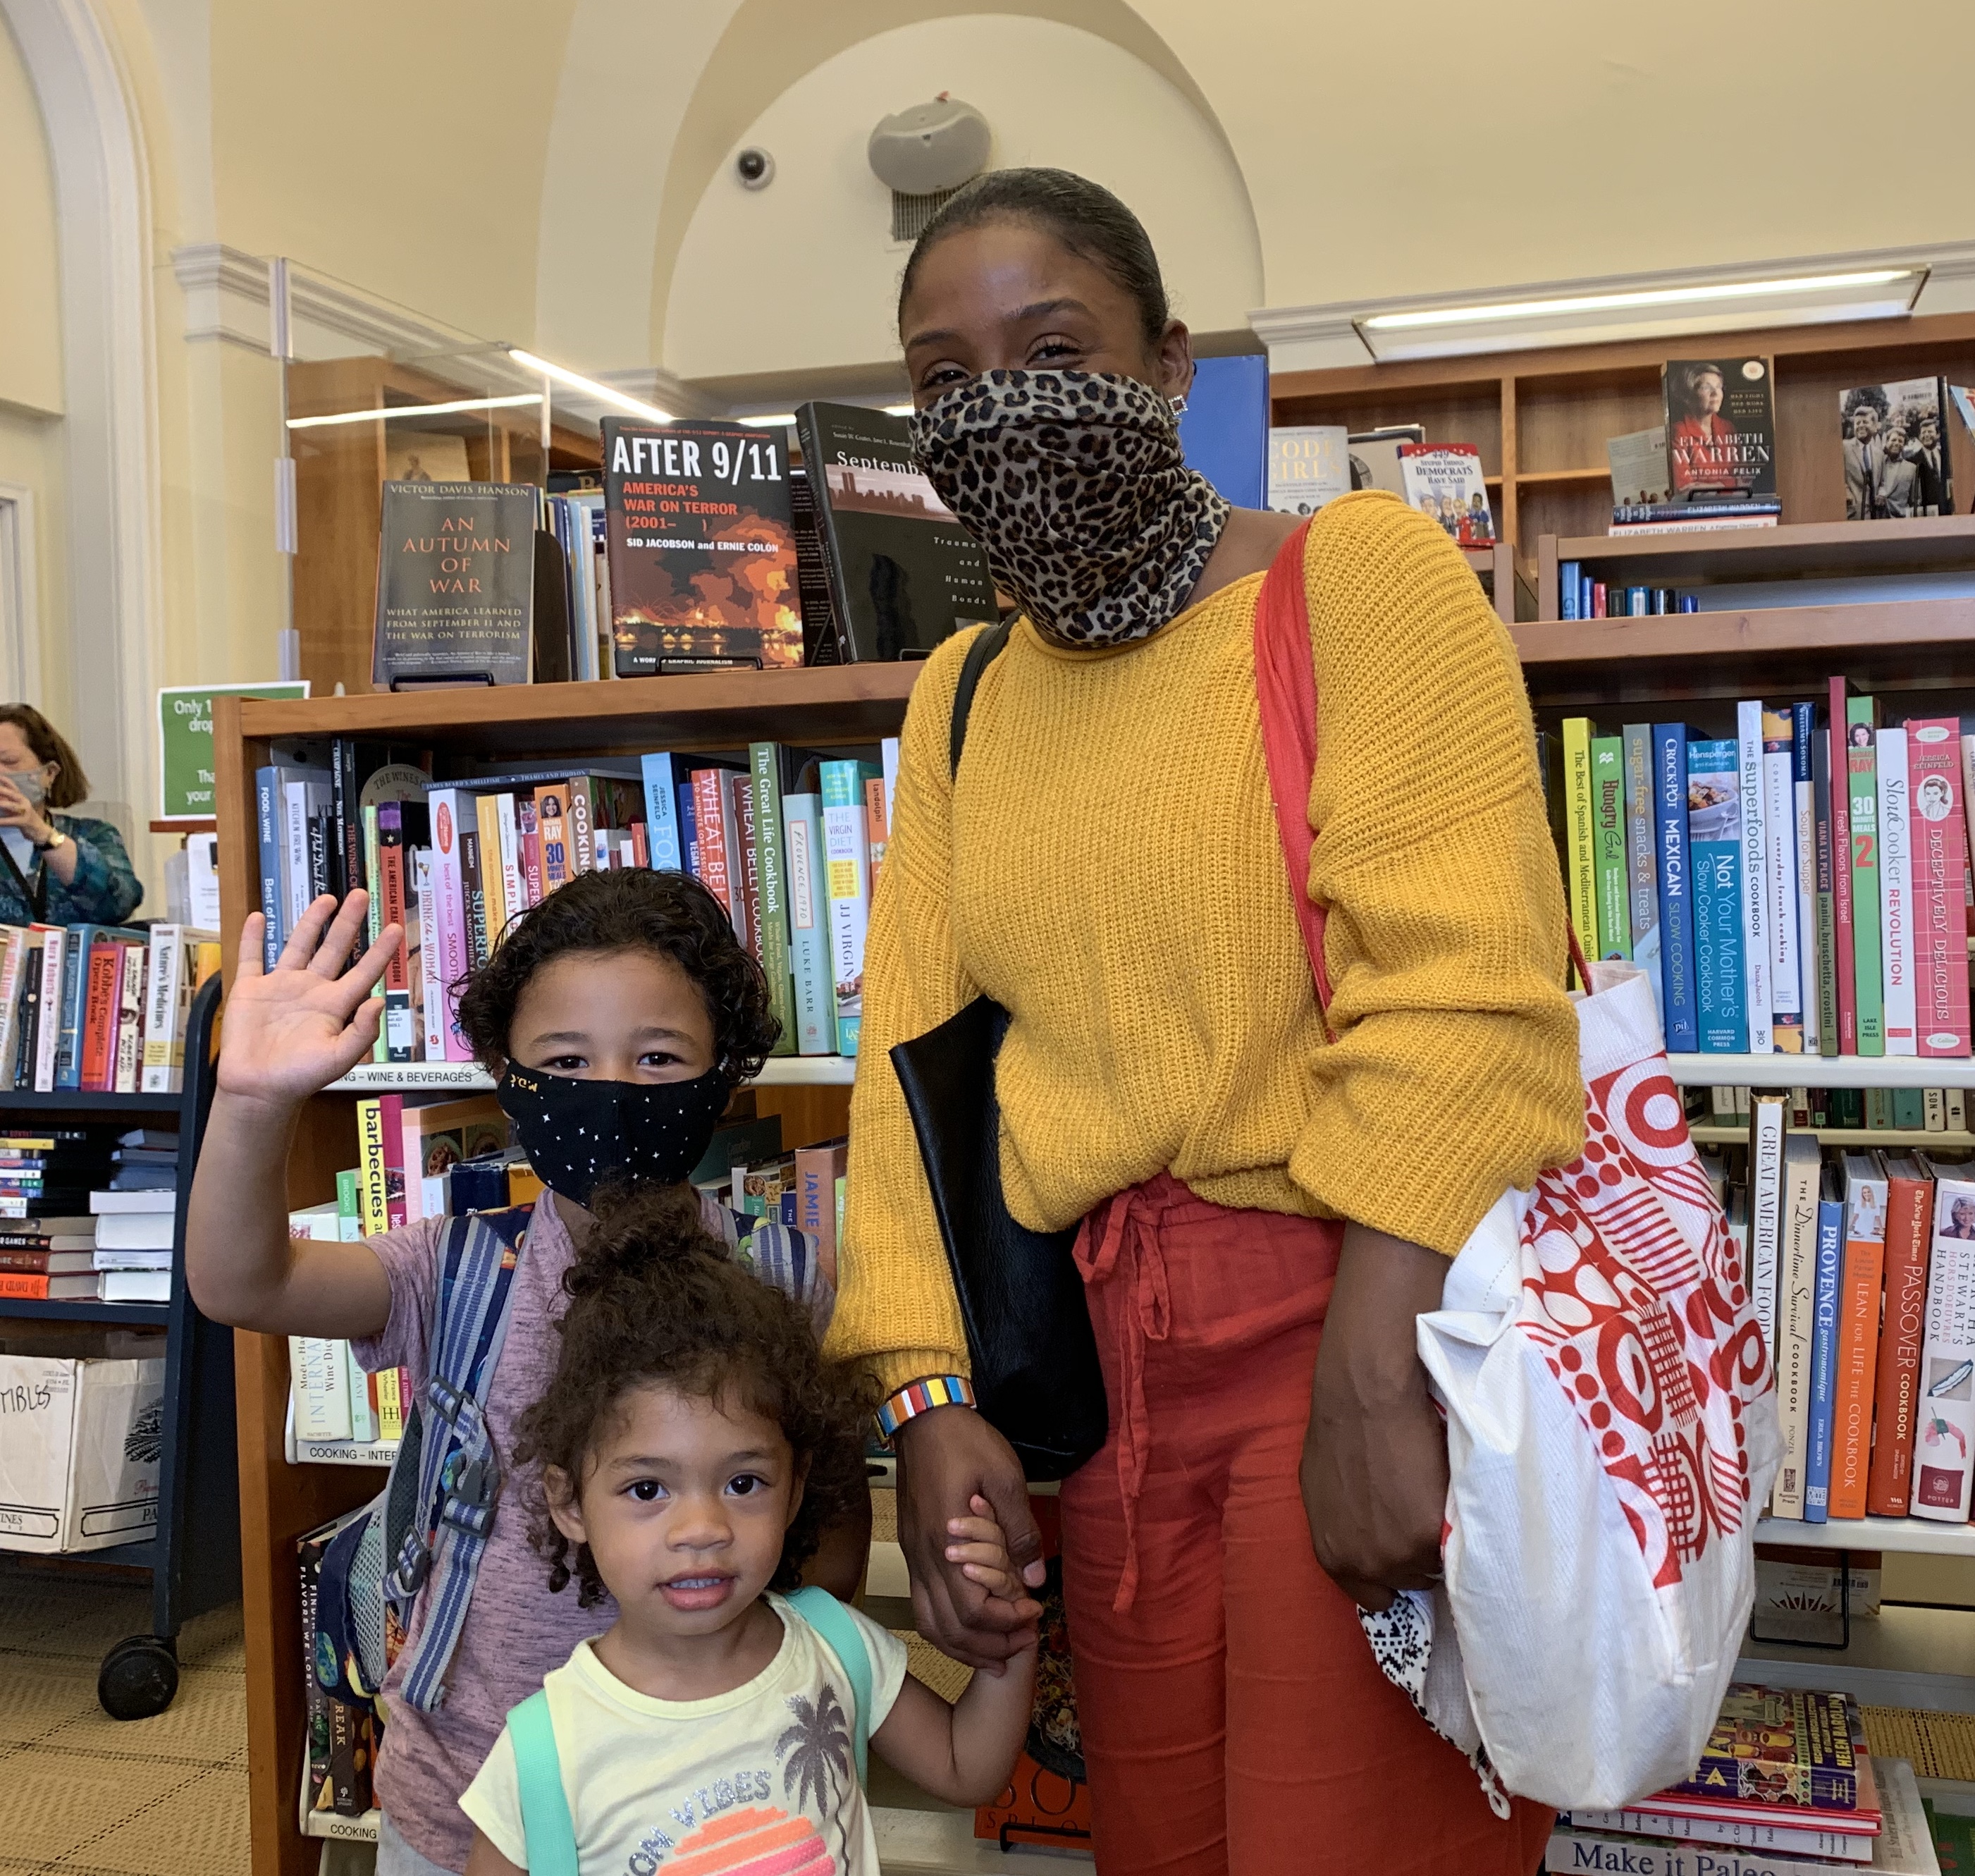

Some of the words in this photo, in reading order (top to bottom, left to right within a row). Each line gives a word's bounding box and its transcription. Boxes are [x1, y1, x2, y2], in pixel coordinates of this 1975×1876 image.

[1673, 446, 1770, 465] WARREN
[1680, 433, 1764, 447] ELIZABETH
[613, 436, 703, 478] AFTER
[712, 439, 782, 486] 9/11
[390, 484, 435, 493] VICTOR
[439, 484, 473, 494] DAVIS
[477, 485, 529, 497] HANSON
[623, 482, 699, 497] AMERICA'S
[624, 498, 656, 512] WAR
[660, 500, 679, 513] ON
[682, 501, 738, 516] TERROR
[1687, 505, 1727, 514] ELIZABETH
[441, 517, 474, 531] AN
[1613, 527, 1664, 537] ELIZABETH
[402, 538, 511, 553] AUTUMN
[627, 538, 644, 547] SID
[646, 539, 695, 549] JACOBSON
[697, 541, 715, 550] and
[718, 541, 746, 551] ERNIE
[934, 537, 977, 548] Trauma
[441, 558, 472, 573] OF
[959, 559, 980, 568] and
[430, 578, 482, 594] WAR
[945, 575, 983, 586] Human
[422, 608, 469, 616] AMERICA
[474, 608, 522, 616] LEARNED
[952, 594, 986, 606] Bonds
[459, 630, 521, 639] TERRORISM
[174, 699, 203, 718] Only
[758, 748, 770, 775] The
[1575, 749, 1585, 770] The
[1689, 749, 1736, 760] Hensperger
[1850, 758, 1874, 773] RAY
[1576, 771, 1585, 791] Best
[1630, 738, 1648, 814] sugar-free
[186, 790, 211, 806] your
[652, 784, 661, 821] SEINFELD
[659, 786, 667, 817] JESSICA
[701, 770, 724, 854] WHEAT
[741, 784, 757, 840] WHEAT
[759, 778, 773, 814] Great
[1600, 779, 1619, 829] Hungry
[1852, 797, 1874, 815] 30
[762, 818, 776, 844] Life
[829, 813, 851, 823] THE
[829, 825, 852, 835] VIRGIN
[1577, 802, 1588, 842] Spanish
[1742, 761, 1763, 874] superfoods
[1800, 810, 1811, 837] Soup
[1837, 810, 1847, 835] Fresh
[1852, 824, 1876, 833] MEALS
[543, 826, 562, 842] RAY
[830, 836, 853, 847] DIET
[1635, 817, 1650, 869] snacks
[546, 842, 565, 864] 30
[1579, 843, 1589, 862] and
[1665, 819, 1682, 897] MEXICAN
[1839, 839, 1848, 872] Flavors
[1855, 835, 1874, 868] 2
[746, 849, 761, 892] BELLY
[764, 847, 780, 914] Cookbook
[1637, 871, 1651, 884] &
[1697, 860, 1710, 893] Slow
[1717, 855, 1735, 890] Not
[1801, 858, 1811, 897] Supper
[1819, 862, 1828, 890] PLACE
[1839, 874, 1850, 896] from
[264, 878, 274, 904] Best
[388, 869, 398, 905] AMERICAN
[505, 864, 517, 914] SIMPLY
[1580, 864, 1591, 932] Mediterranean
[797, 894, 808, 919] 1970
[1638, 888, 1649, 931] treats
[1669, 902, 1681, 940] SLOW
[1699, 895, 1711, 943] Cooker
[1718, 892, 1736, 931] Your
[1751, 876, 1760, 938] COOKBOOK
[1820, 897, 1831, 931] panini,
[1840, 899, 1851, 924] Israel
[266, 918, 276, 940] the
[1889, 889, 1902, 986] REVOLUTION
[267, 943, 278, 969] Best
[802, 940, 812, 974] LUKE
[1821, 933, 1833, 989] bruschetta,
[1671, 943, 1686, 1007] COOKING
[1700, 945, 1714, 1013] Cookbook
[1934, 939, 1950, 1020] DELICIOUS
[805, 980, 814, 1013] BARR
[1823, 991, 1833, 1029] crostini
[367, 1072, 394, 1082] WINE
[397, 1072, 404, 1082] &
[407, 1072, 472, 1082] BEVERAGES
[366, 1108, 383, 1218] barbecues
[1761, 1126, 1778, 1185] GREAT
[342, 1179, 351, 1213] BROOKS
[805, 1172, 820, 1227] JAMIE
[1757, 1188, 1776, 1280] AMERICAN
[1792, 1204, 1814, 1280] Dinnertime
[1819, 1225, 1838, 1327] PROVENCE
[1790, 1280, 1810, 1343] Survival
[1857, 1283, 1869, 1318] LEAN
[1930, 1249, 1947, 1342] HANDBOOK
[1952, 1253, 1970, 1345] STEWART'S
[1897, 1265, 1923, 1368] PASSOVER
[1942, 1284, 1955, 1344] D'OEUVRES
[1854, 1323, 1864, 1342] FOR
[1816, 1328, 1829, 1403] gastronomique
[1852, 1348, 1865, 1375] LIFE
[326, 1364, 335, 1392] Wine
[1790, 1344, 1800, 1413] COOKBOOK
[1850, 1380, 1859, 1399] THE
[1896, 1373, 1910, 1440] COOKBOOK
[309, 1447, 357, 1460] COOKING
[1845, 1404, 1861, 1488] COOKBOOK
[1927, 1495, 1955, 1504] POTTER
[300, 1566, 309, 1624] FLAVORS
[304, 1631, 310, 1650] WE
[1835, 1738, 1853, 1768] HELEN
[668, 1768, 772, 1829] VIBES
[331, 1824, 377, 1839] COOKING
[1573, 1842, 1654, 1875] Make
[1666, 1852, 1686, 1876] it
